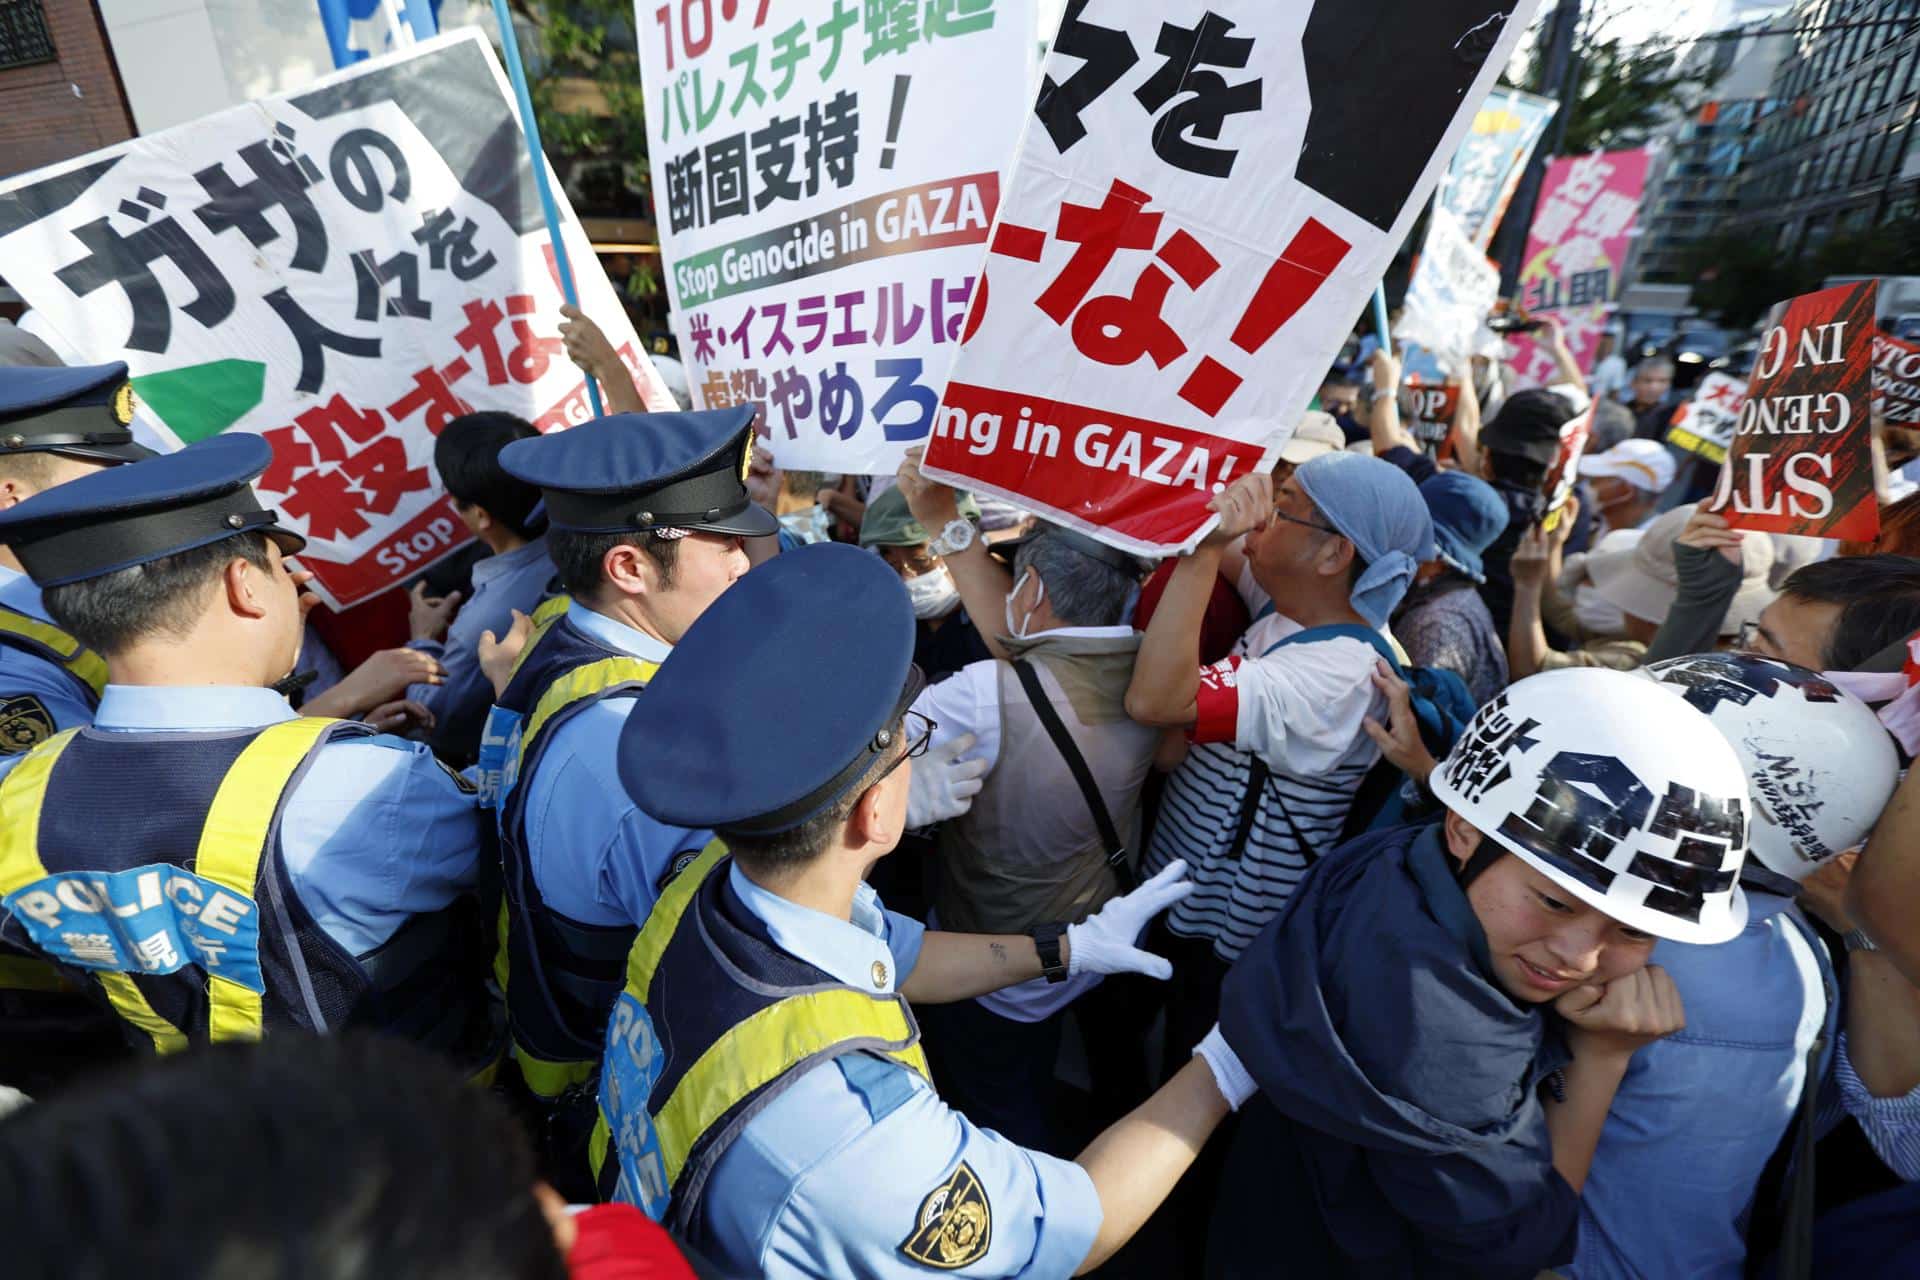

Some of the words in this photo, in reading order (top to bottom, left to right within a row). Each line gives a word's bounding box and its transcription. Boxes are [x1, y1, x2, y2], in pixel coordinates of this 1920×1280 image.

[665, 74, 912, 235] 断固支持！
[54, 121, 411, 355] ガザの
[676, 262, 717, 299] Stop
[721, 221, 835, 286] Genocide
[840, 211, 869, 255] in
[875, 183, 988, 244] GAZA
[262, 207, 497, 395] 人々を
[1793, 321, 1848, 368] IN
[1013, 406, 1061, 458] in
[1074, 423, 1238, 495] GAZA!
[376, 517, 454, 575] Stop
[16, 871, 250, 936] POLICE
